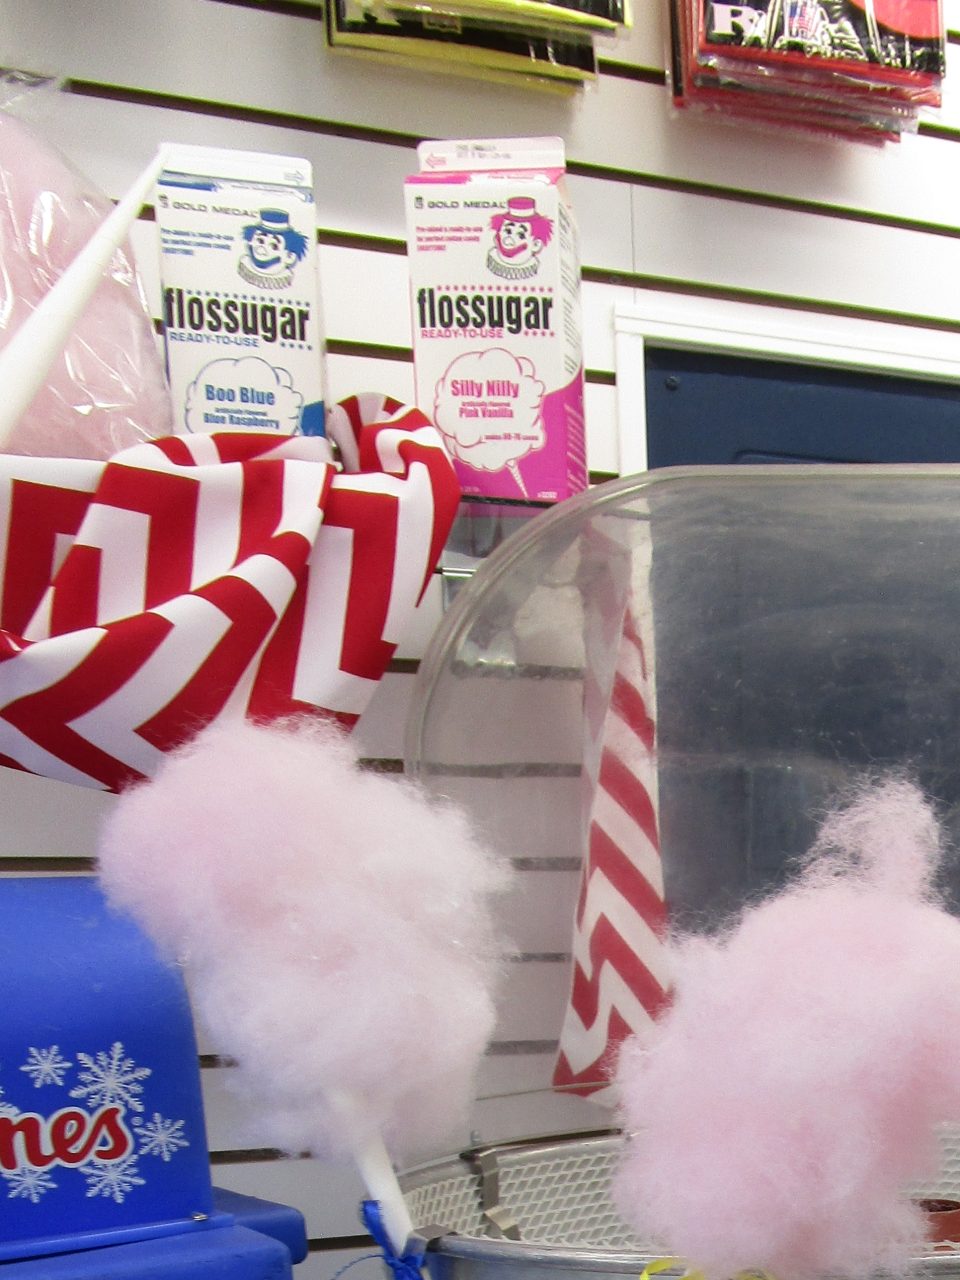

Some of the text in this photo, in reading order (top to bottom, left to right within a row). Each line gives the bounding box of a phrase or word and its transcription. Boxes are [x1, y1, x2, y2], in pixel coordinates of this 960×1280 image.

[172, 201, 257, 219] GOLD MEDAL
[427, 200, 506, 209] GOLD MEDAL
[164, 287, 310, 342] flossugar
[417, 287, 553, 334] flossugar
[170, 332, 260, 348] READY-TO-USE
[421, 329, 504, 339] READY-TO-USE
[205, 384, 276, 406] Boo Blue
[451, 380, 520, 397] Silly Nilly
[204, 413, 280, 430] Blue Raspberry
[459, 407, 514, 419] Pink Vanilla
